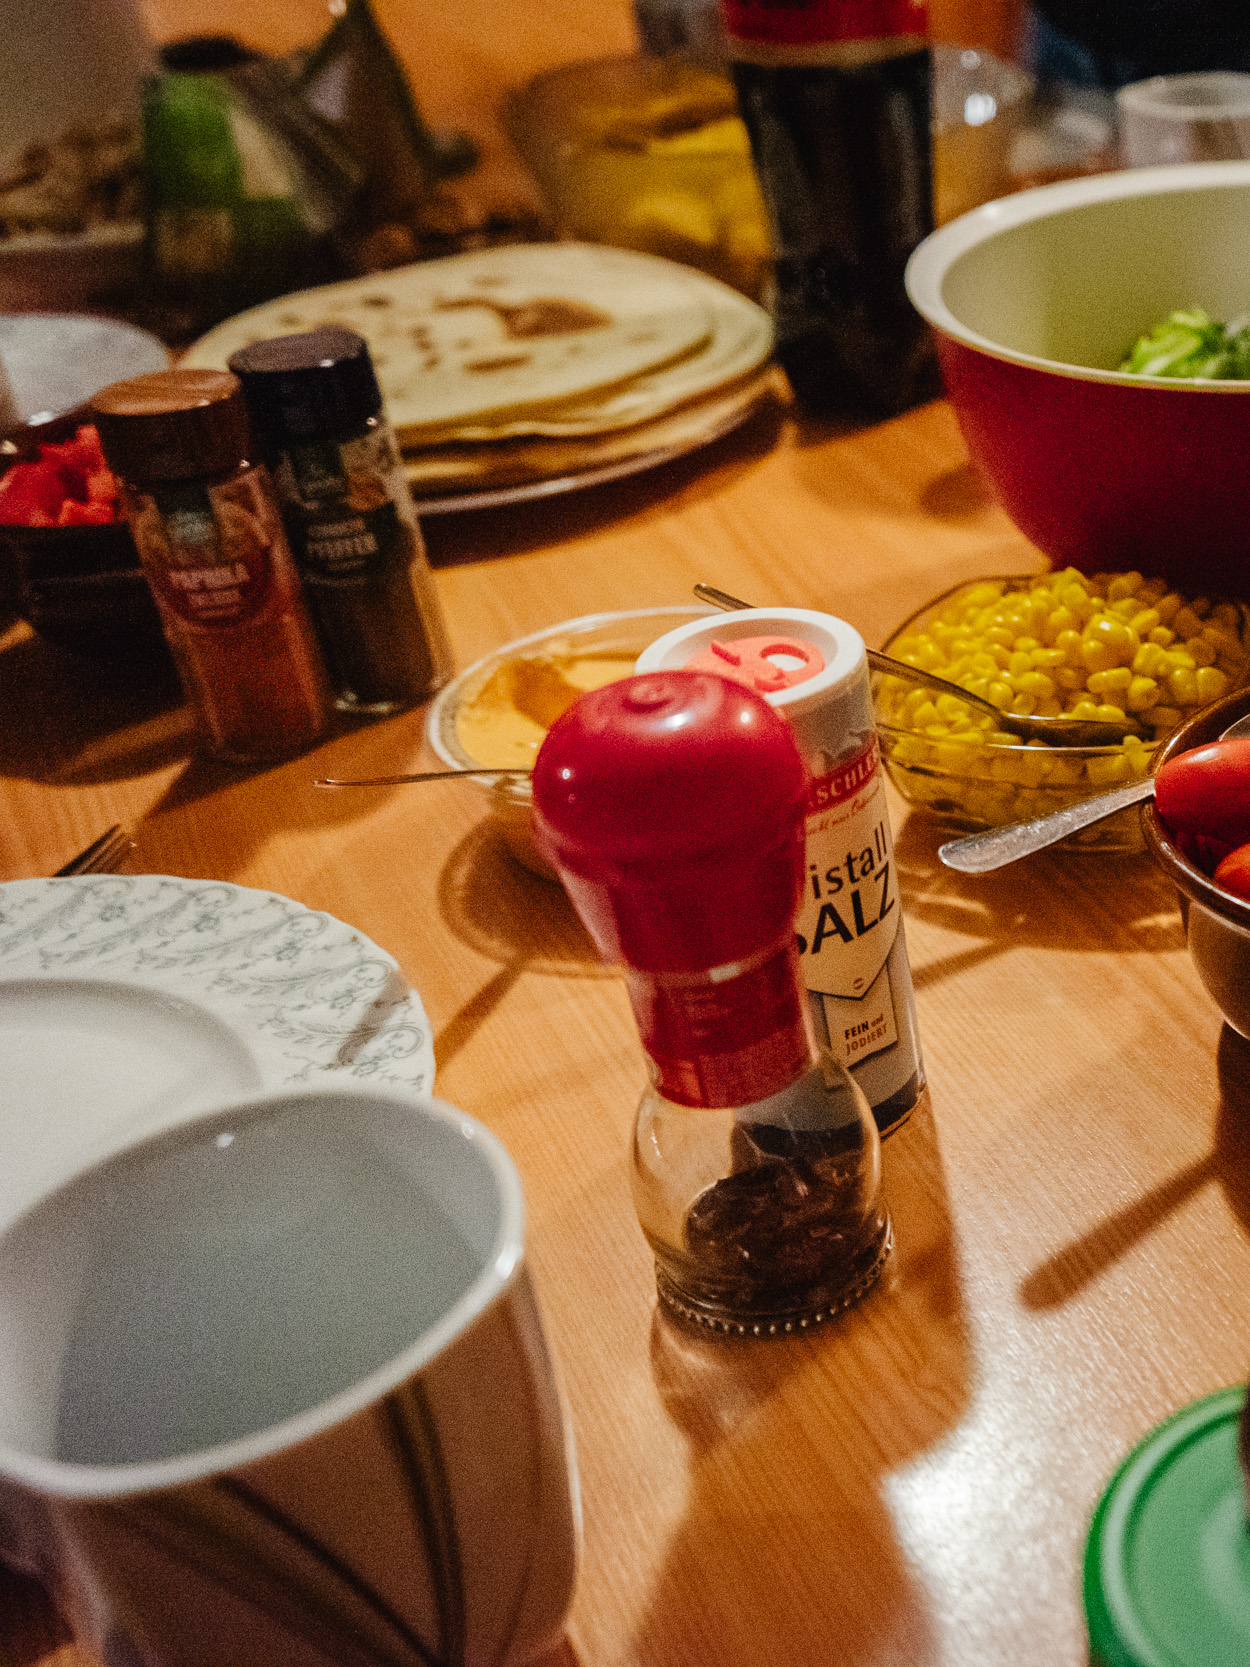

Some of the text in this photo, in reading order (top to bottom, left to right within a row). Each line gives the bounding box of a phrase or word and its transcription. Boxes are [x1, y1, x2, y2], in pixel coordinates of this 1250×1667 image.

[809, 821, 888, 900] istall
[844, 1020, 870, 1039] FEIN
[846, 1023, 888, 1056] JODIERT
